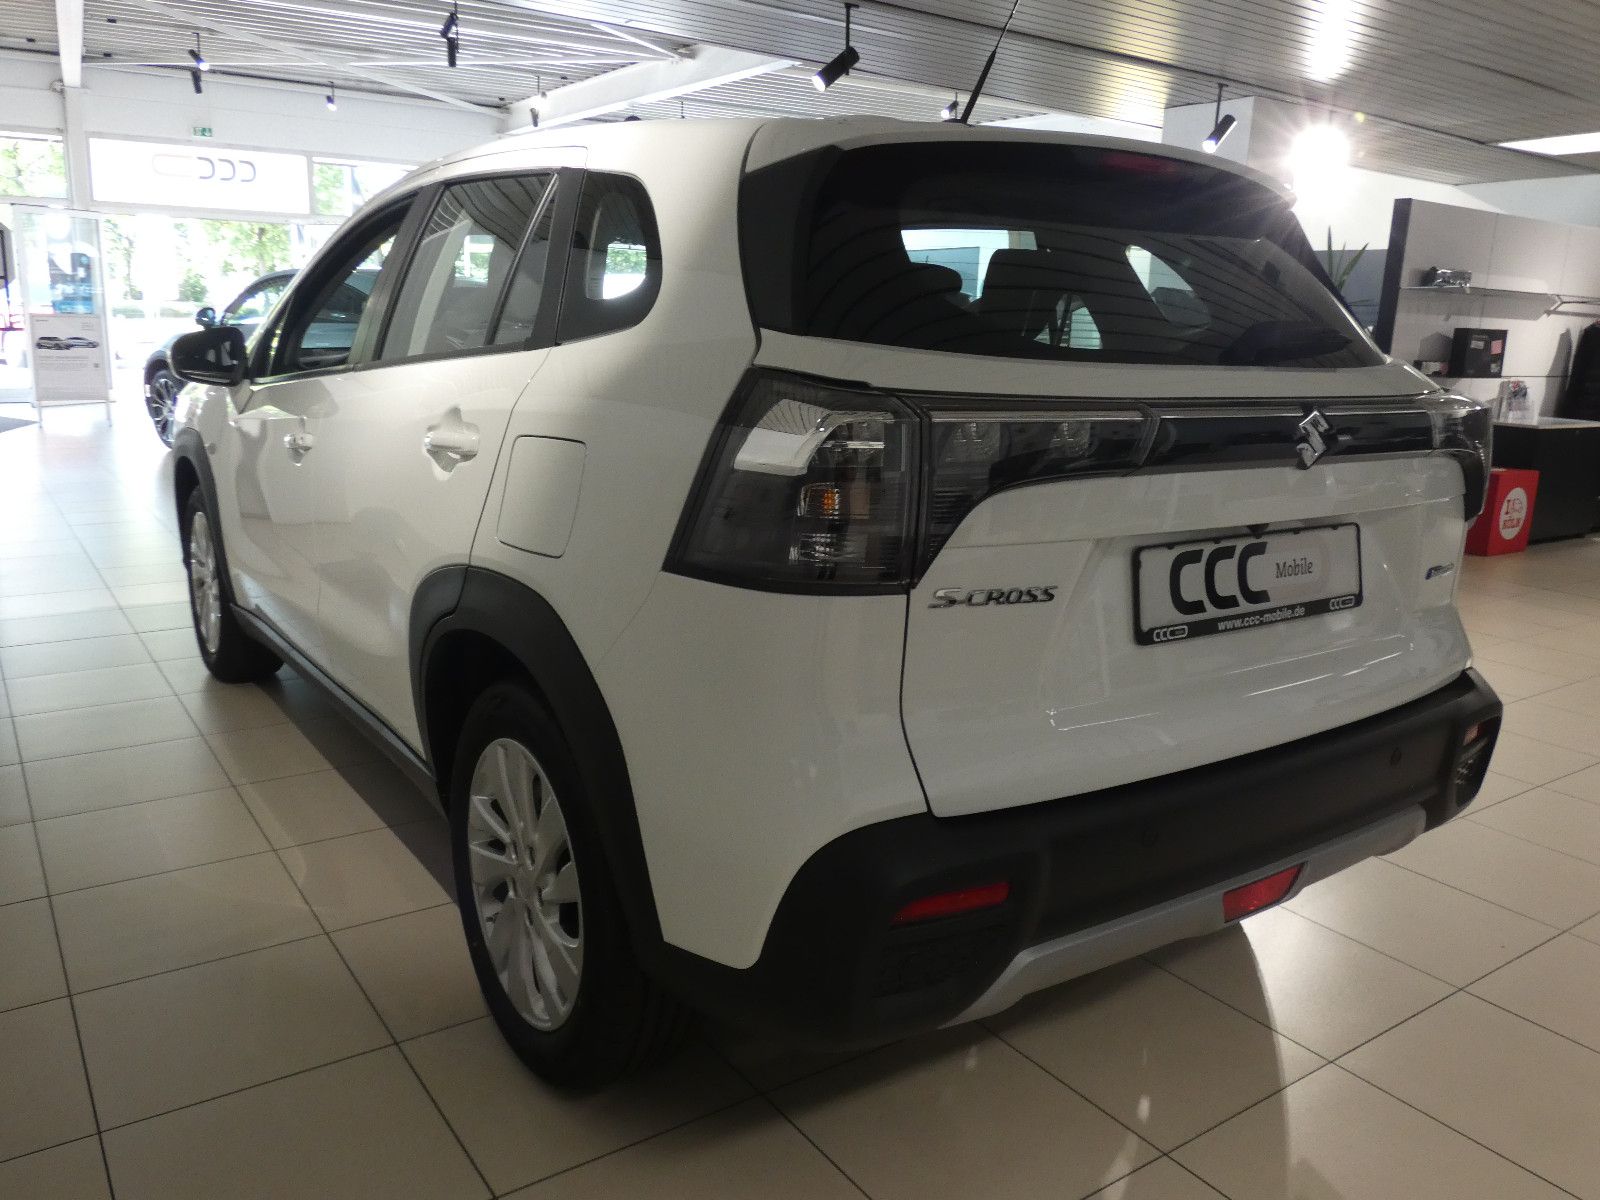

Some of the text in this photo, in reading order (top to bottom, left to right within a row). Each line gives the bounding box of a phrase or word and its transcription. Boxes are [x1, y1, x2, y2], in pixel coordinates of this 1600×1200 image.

[1169, 541, 1313, 616] CCC Mobile
[928, 585, 1058, 608] S-CROSS
[1217, 605, 1306, 631] www.ccc-mobile.de
